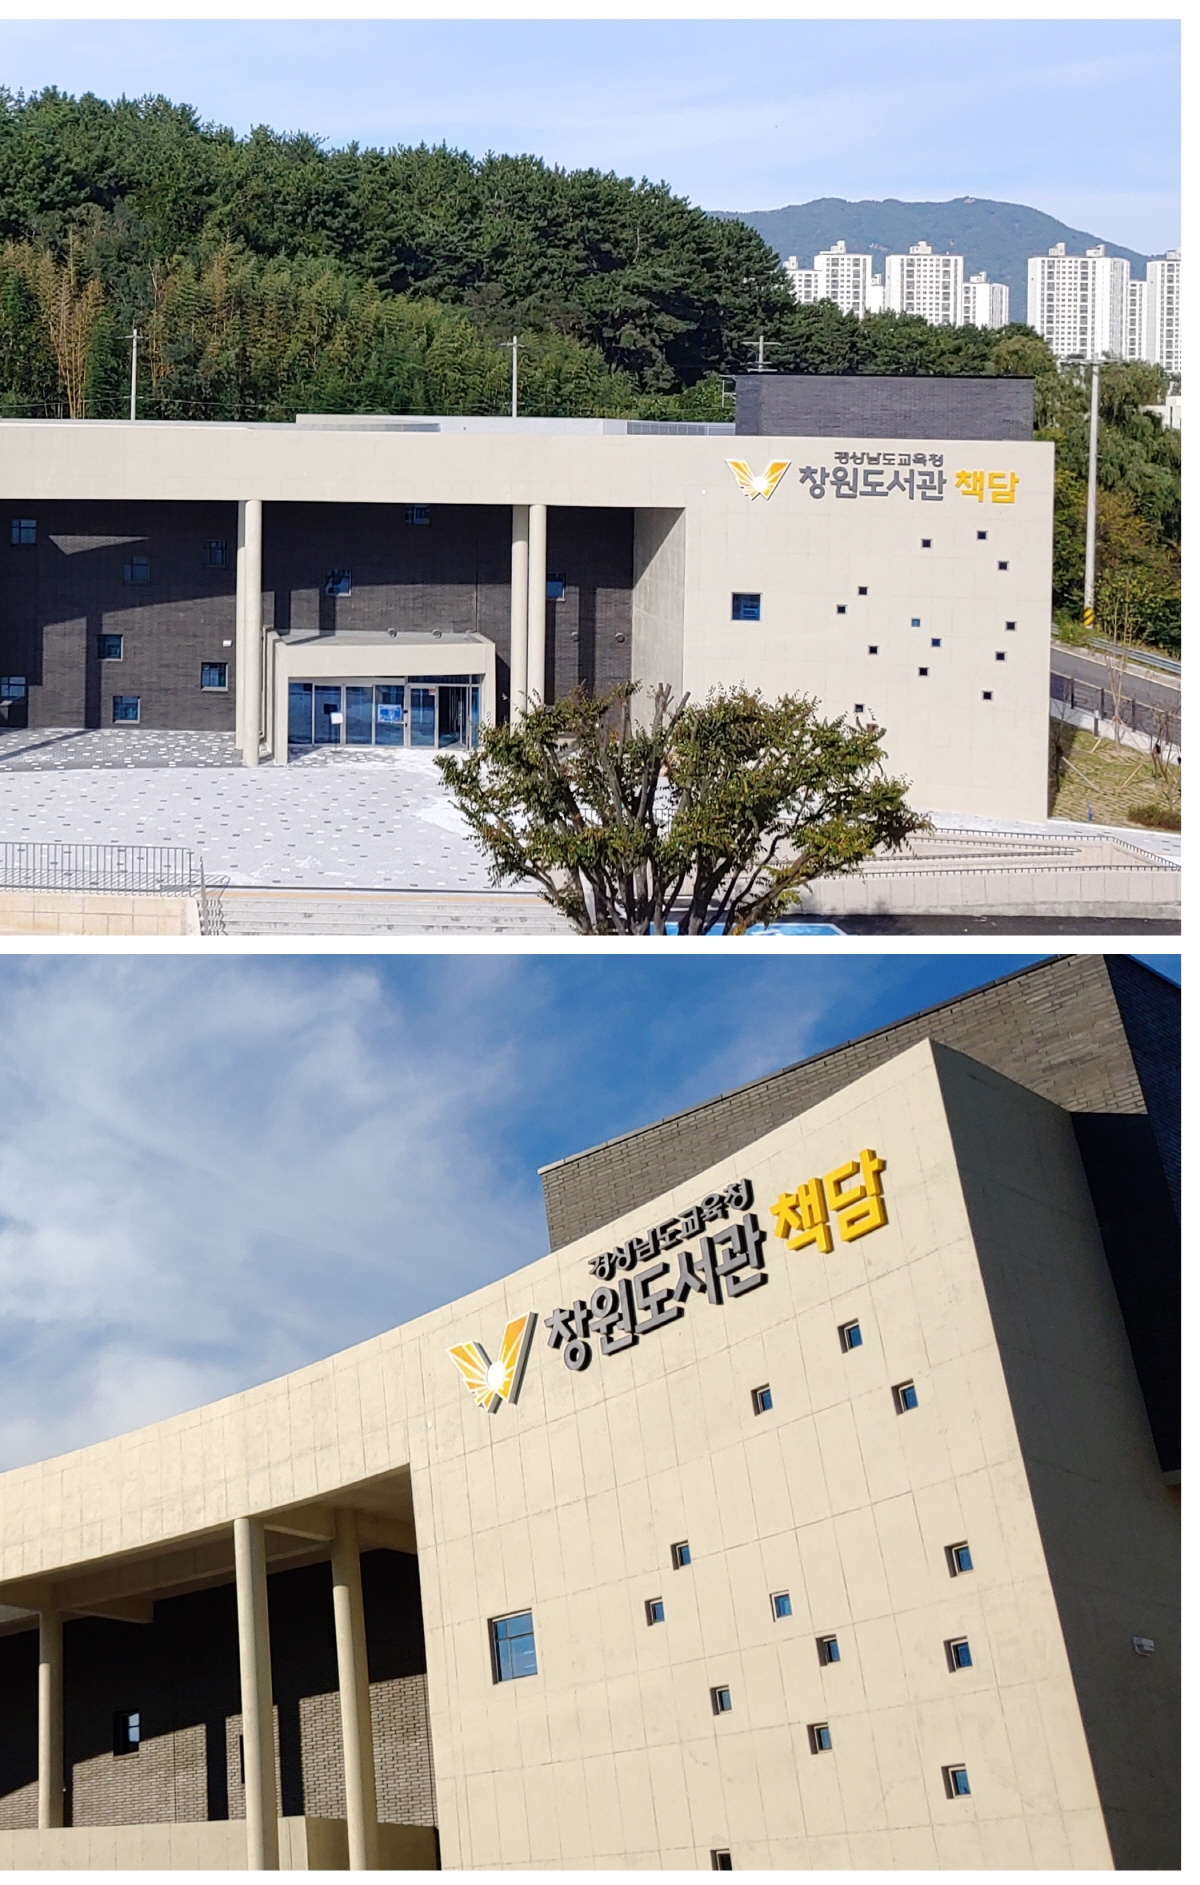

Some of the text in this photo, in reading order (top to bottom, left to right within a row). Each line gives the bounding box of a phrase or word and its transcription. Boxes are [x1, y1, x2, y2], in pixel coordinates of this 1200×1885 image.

[799, 465, 1020, 504] 창원도서관 책담
[834, 451, 944, 467] 경상남도교육청
[544, 1148, 888, 1371] 창원도서관 책담
[588, 1178, 755, 1281] 경상남도교육청
